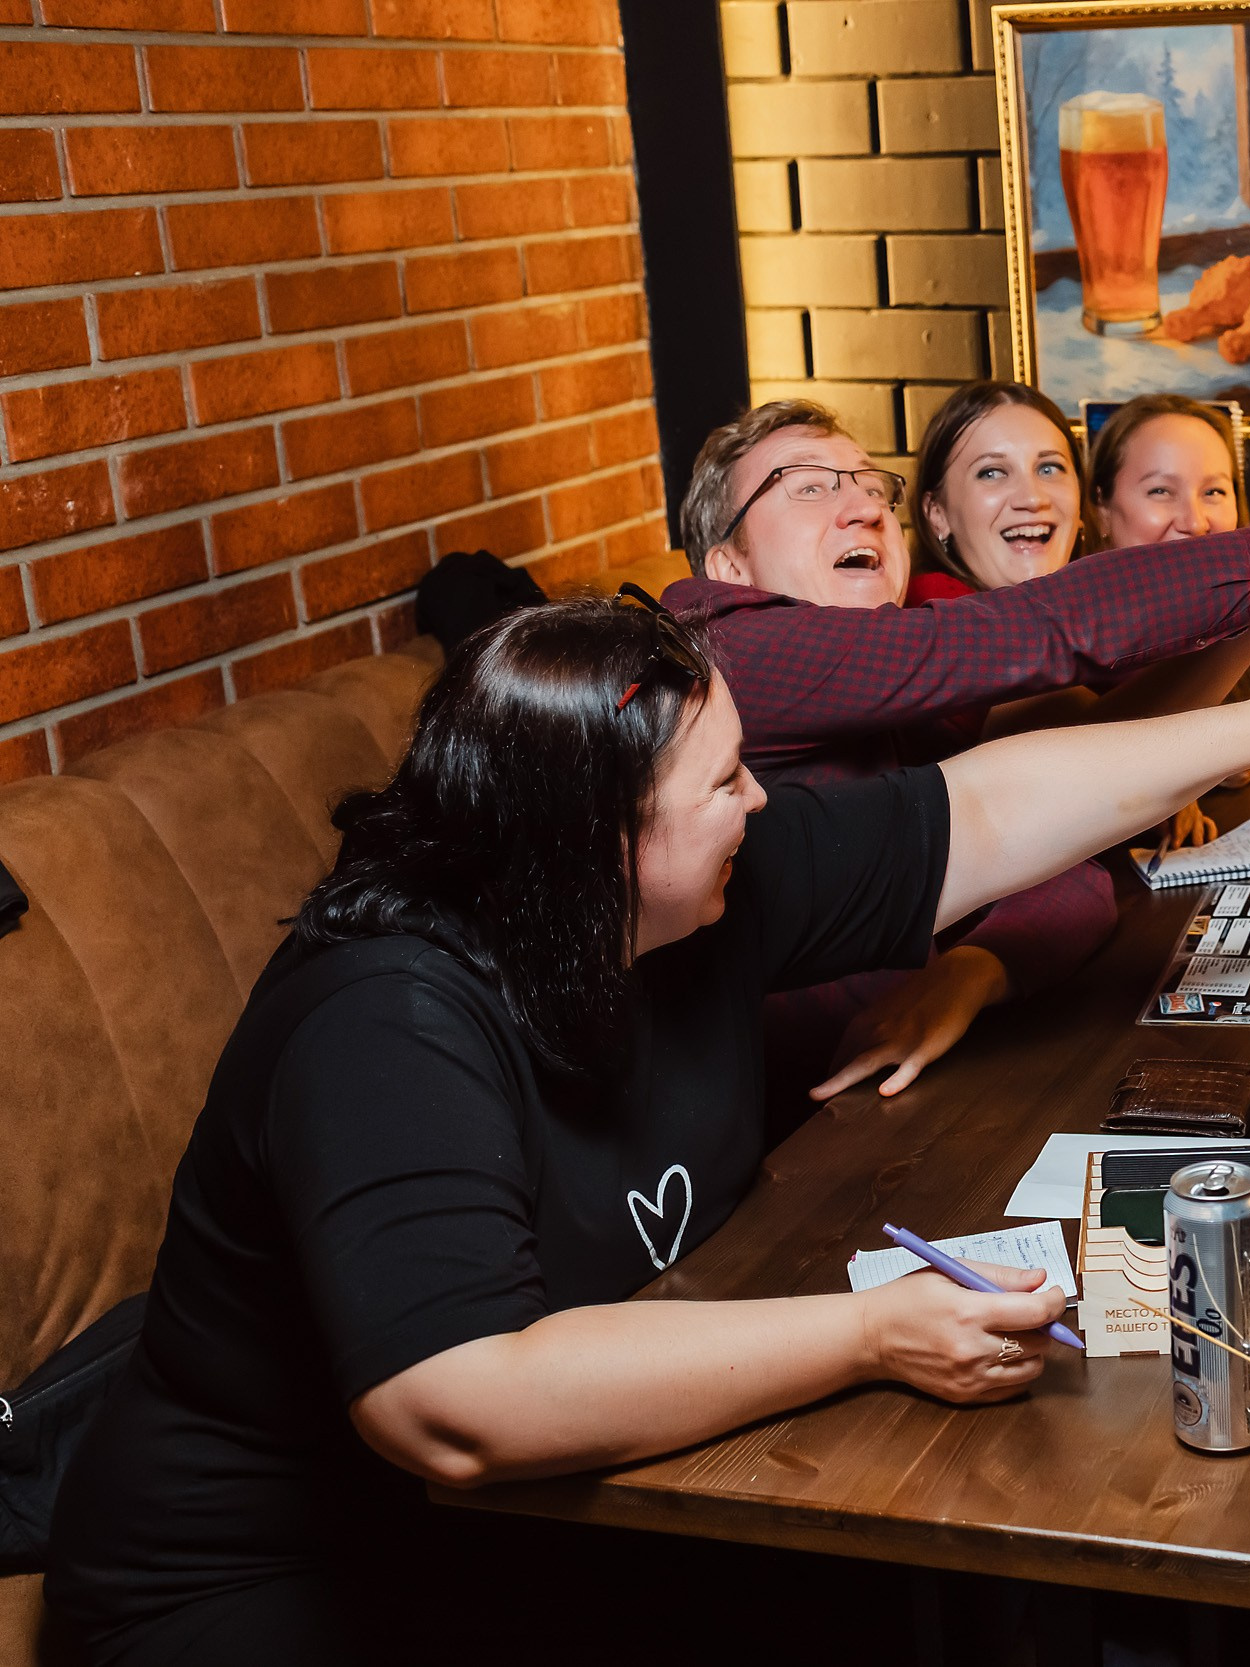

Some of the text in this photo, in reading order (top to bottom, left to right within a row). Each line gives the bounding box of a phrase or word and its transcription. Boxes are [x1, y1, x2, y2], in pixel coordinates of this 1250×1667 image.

[1105, 1308, 1150, 1318] МЕСТО
[1168, 1249, 1200, 1378] EFES
[1106, 1322, 1158, 1333] ВАШЕГО
